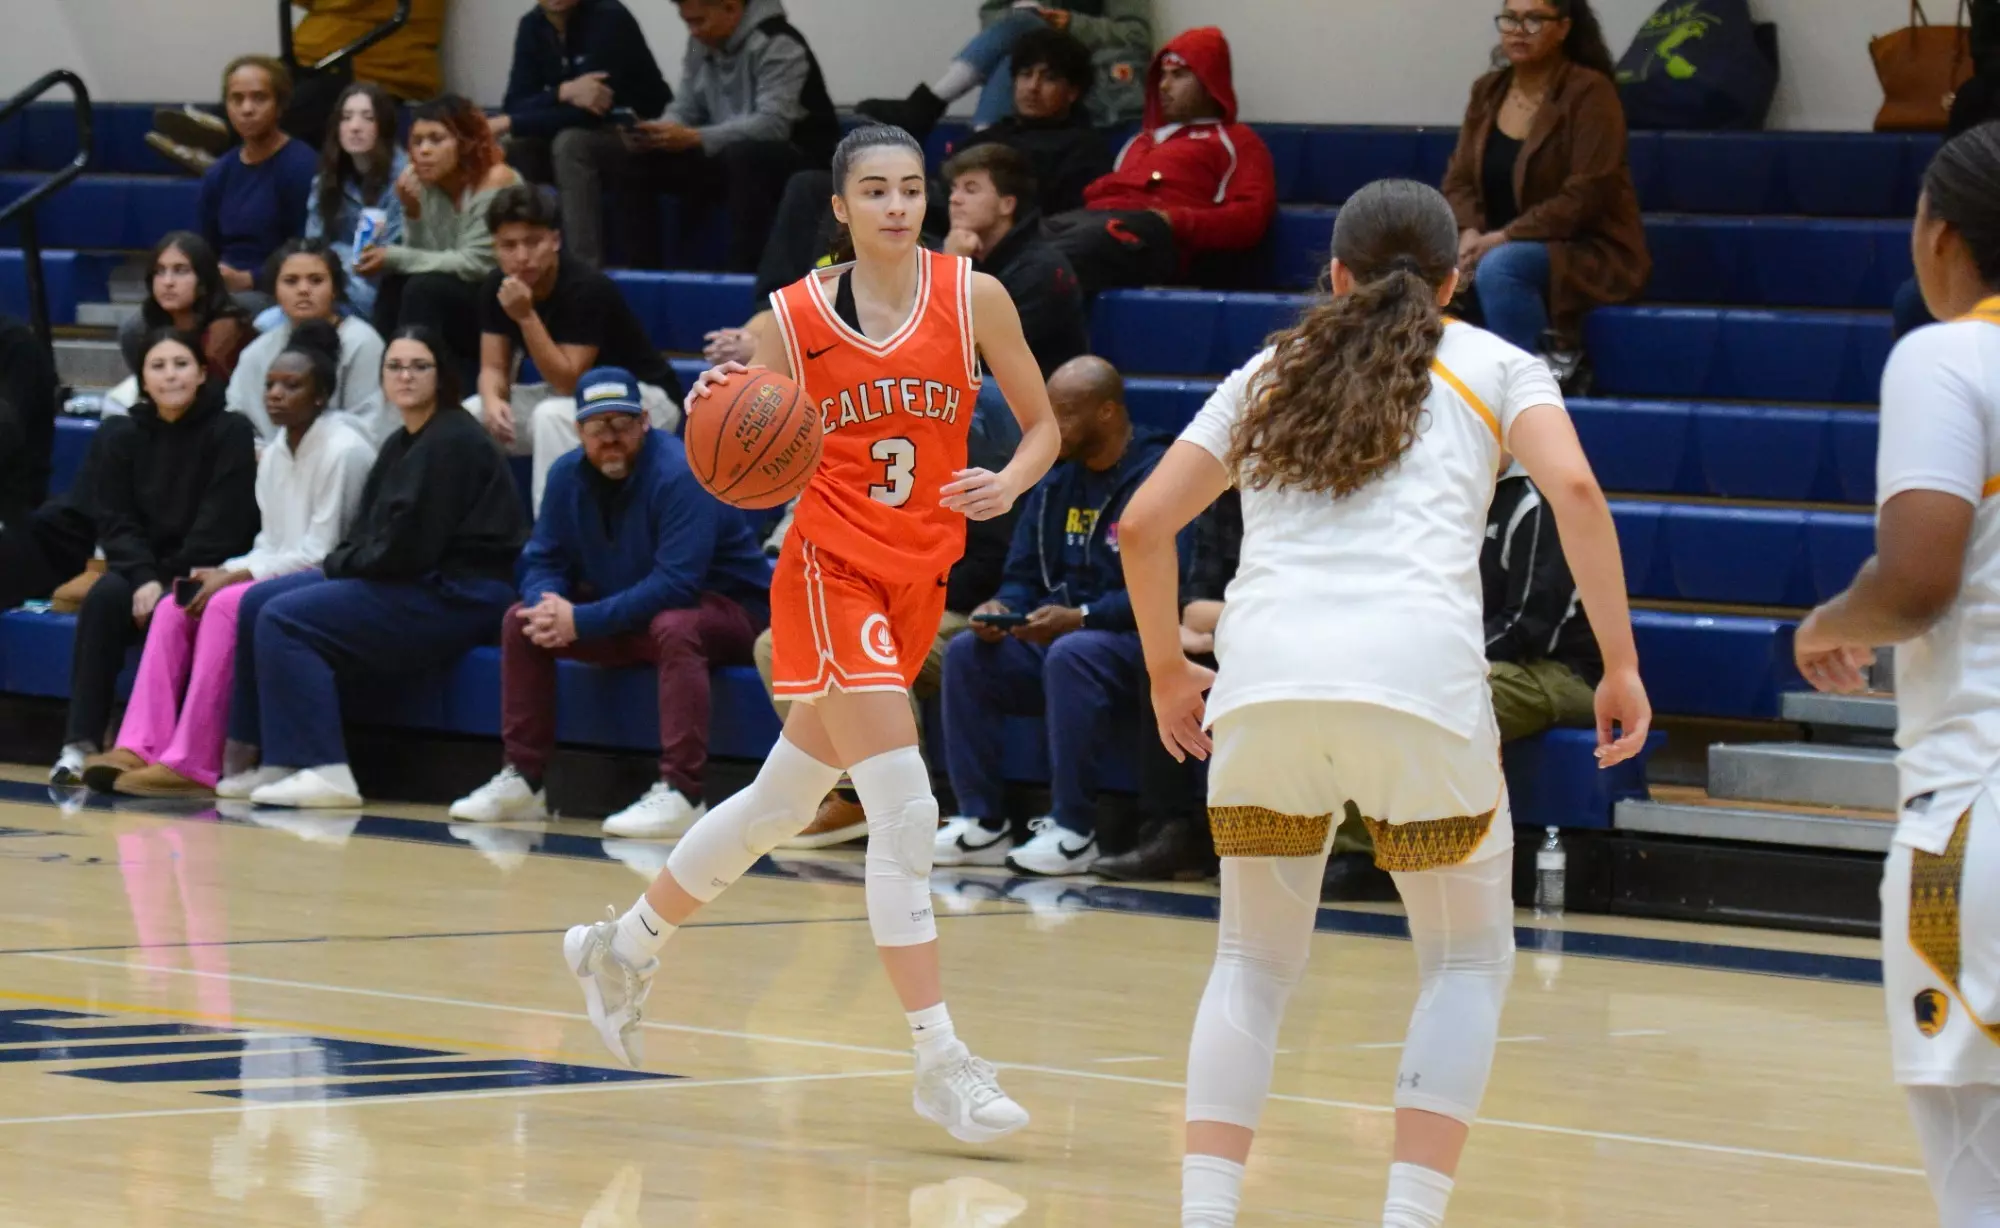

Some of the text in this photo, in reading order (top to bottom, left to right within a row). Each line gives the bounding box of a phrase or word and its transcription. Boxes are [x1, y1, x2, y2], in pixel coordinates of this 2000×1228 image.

[741, 384, 788, 453] LEGACY
[761, 401, 817, 478] SPALDING
[821, 377, 961, 435] CALTECH
[868, 437, 917, 507] 3
